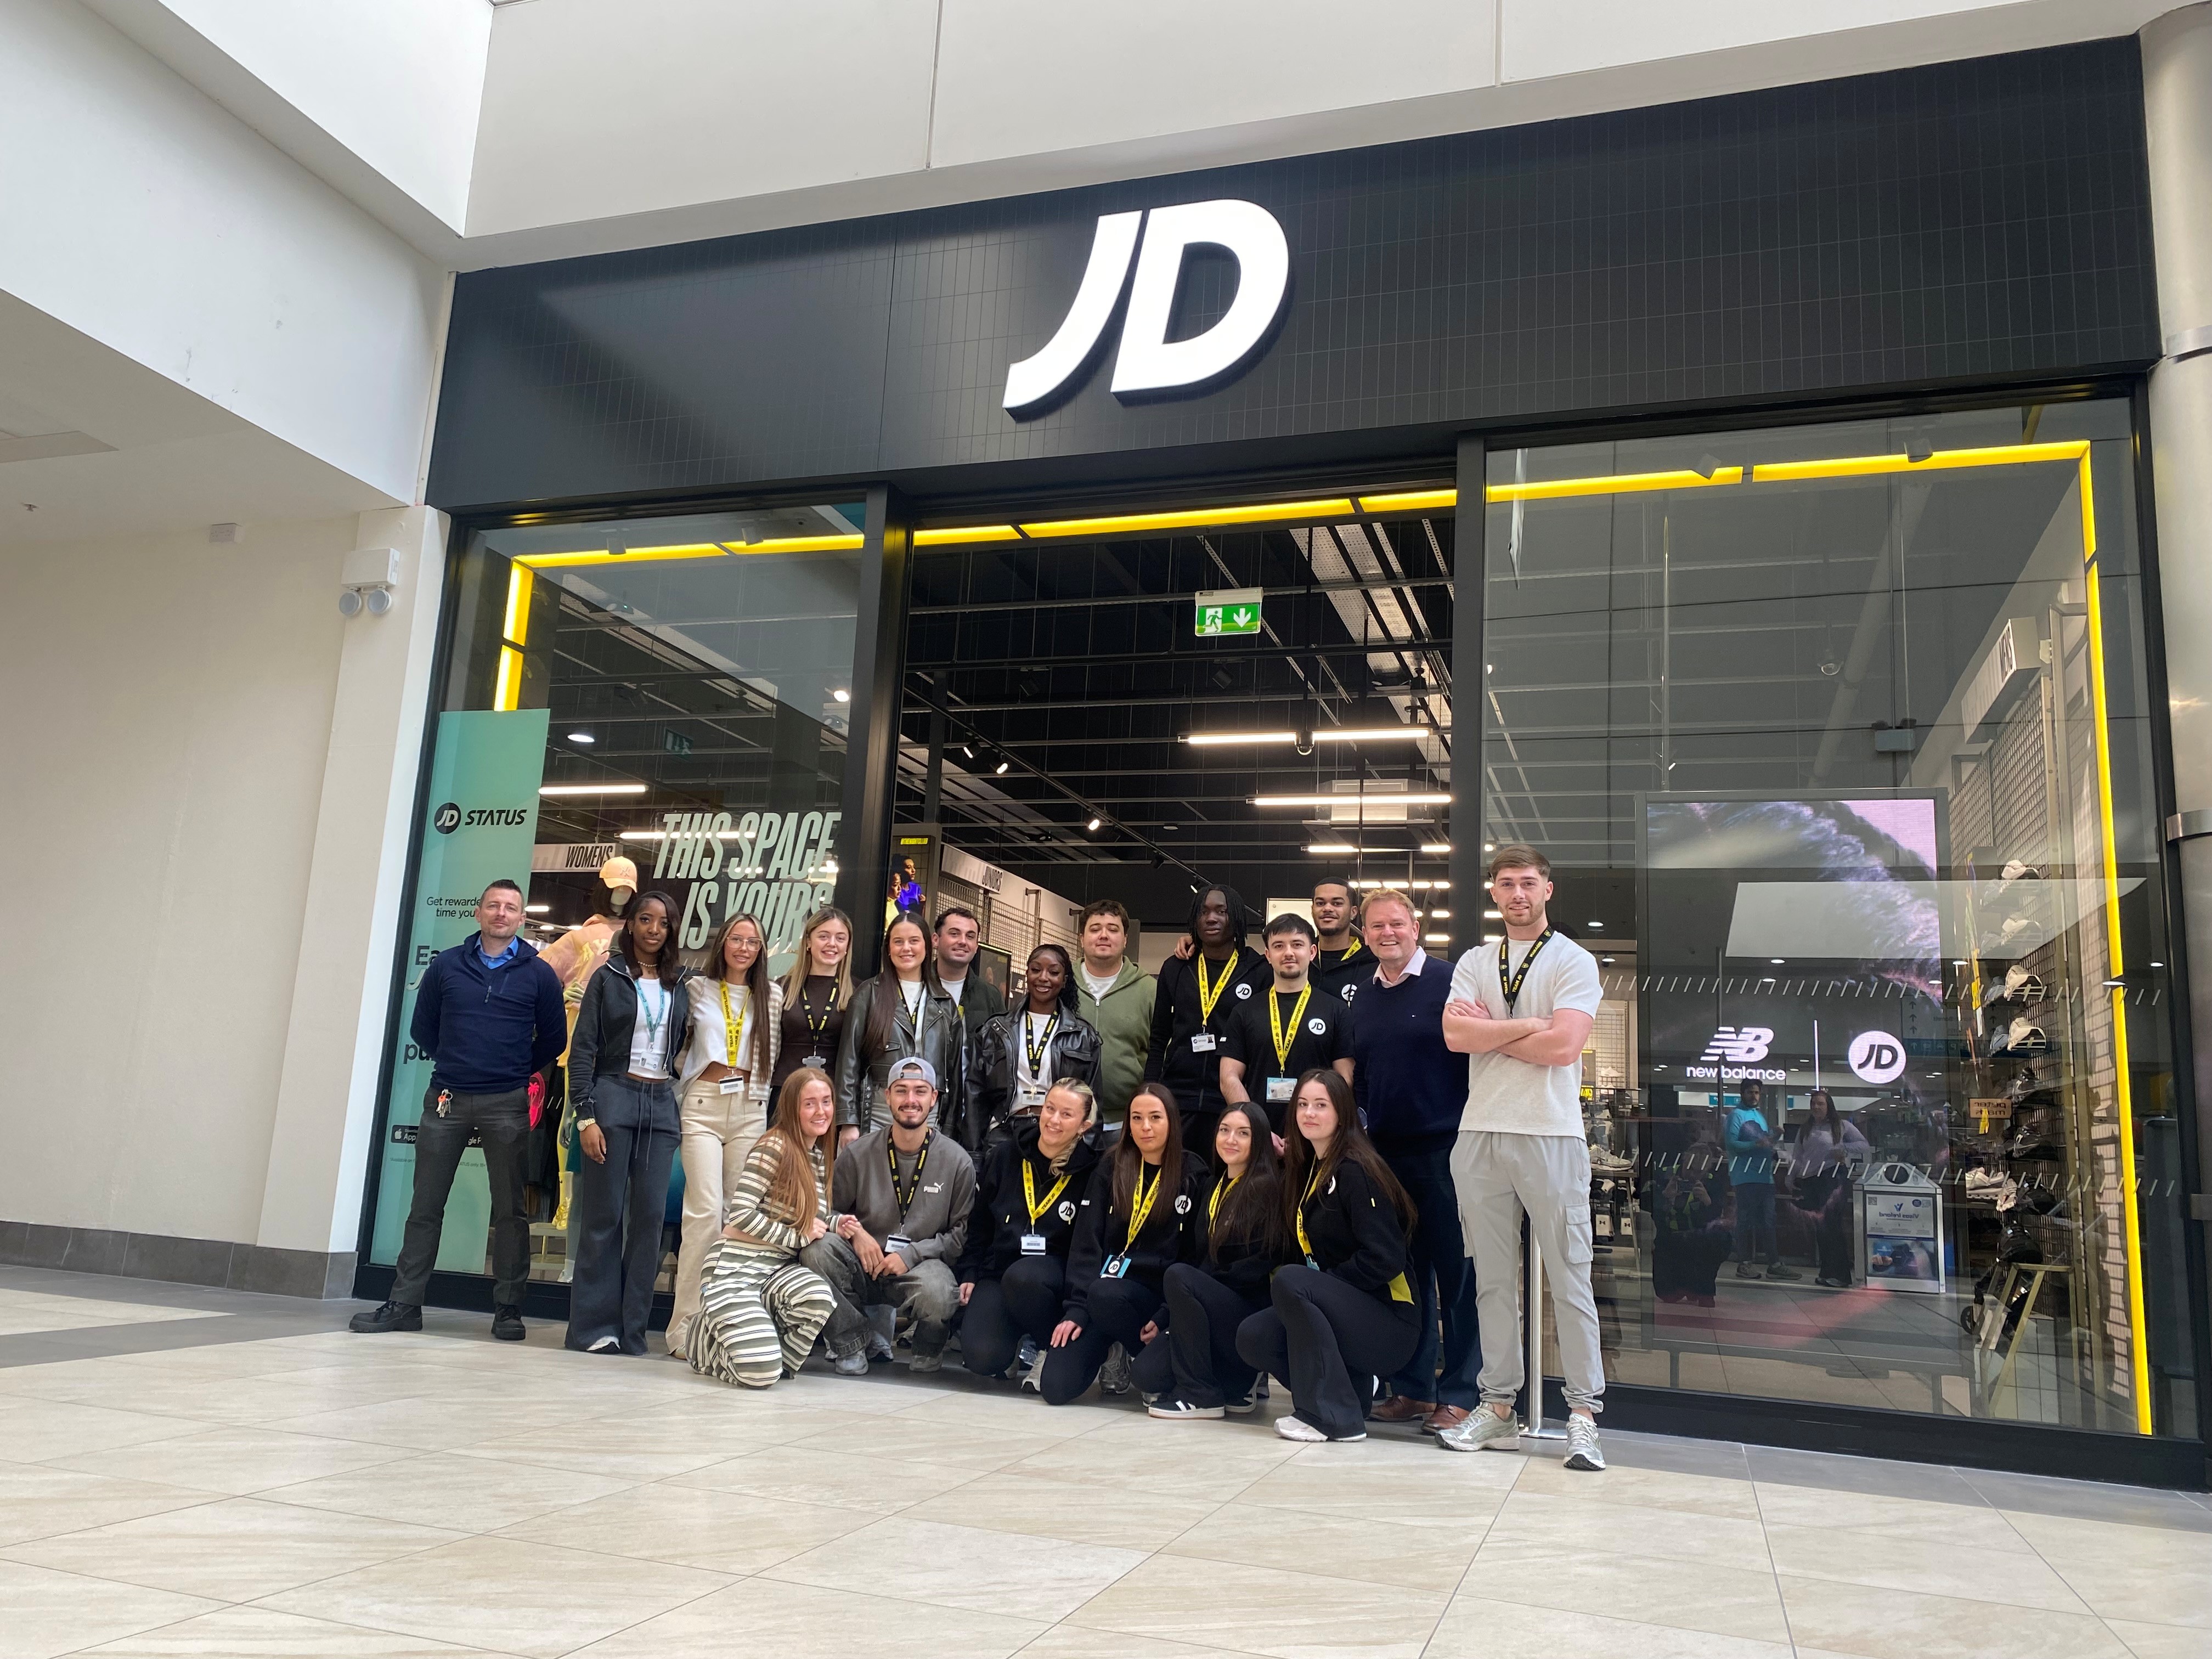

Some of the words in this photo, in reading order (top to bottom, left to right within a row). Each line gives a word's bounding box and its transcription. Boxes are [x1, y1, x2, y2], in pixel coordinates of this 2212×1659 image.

[1002, 199, 1289, 408] JD
[1999, 626, 2012, 683] MENS
[436, 809, 459, 827] JD
[465, 809, 527, 826] STATUS
[653, 812, 730, 879] THIS
[730, 811, 842, 878] SPACE
[565, 845, 613, 868] WOMENS
[982, 866, 1002, 891] JUNIORS
[427, 897, 443, 906] Get
[436, 908, 456, 917] time
[458, 910, 475, 919] you
[678, 881, 719, 950] IS
[1238, 988, 1250, 996] JD
[1512, 980, 1520, 992] TEAM
[1858, 1044, 1898, 1070] JD
[1686, 1066, 1717, 1079] new
[1721, 1065, 1786, 1080] balance
[403, 1133, 416, 1142] App
[1041, 1198, 1051, 1210] TEAM
[1060, 1206, 1073, 1217] JD
[1177, 1200, 1188, 1208] JD
